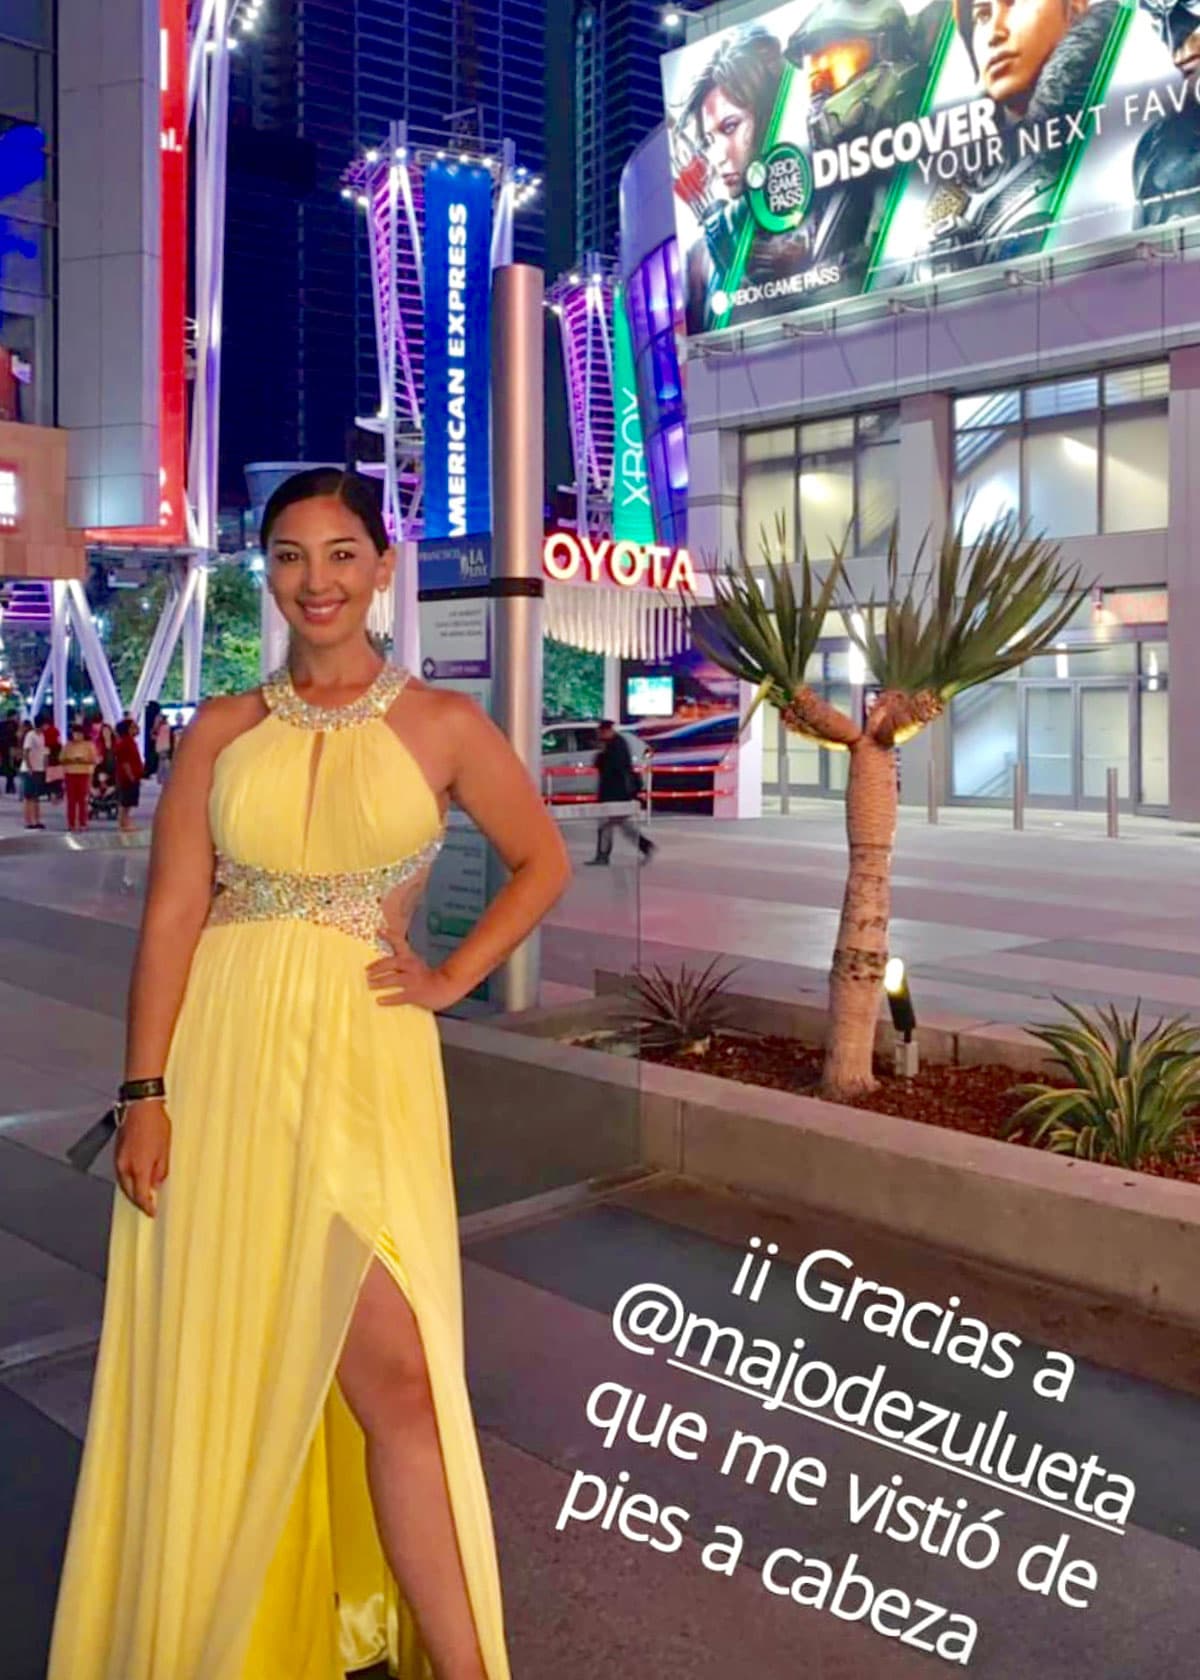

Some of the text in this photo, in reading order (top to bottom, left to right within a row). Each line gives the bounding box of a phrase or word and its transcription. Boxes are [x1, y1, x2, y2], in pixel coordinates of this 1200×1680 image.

[811, 97, 999, 190] DISCOVER
[917, 78, 1200, 185] YOUR NEXT FAV
[768, 171, 802, 195] GAME
[770, 188, 805, 212] PASS
[449, 203, 467, 357] EXPRESS
[763, 273, 803, 299] GAME
[803, 265, 840, 289] PASS
